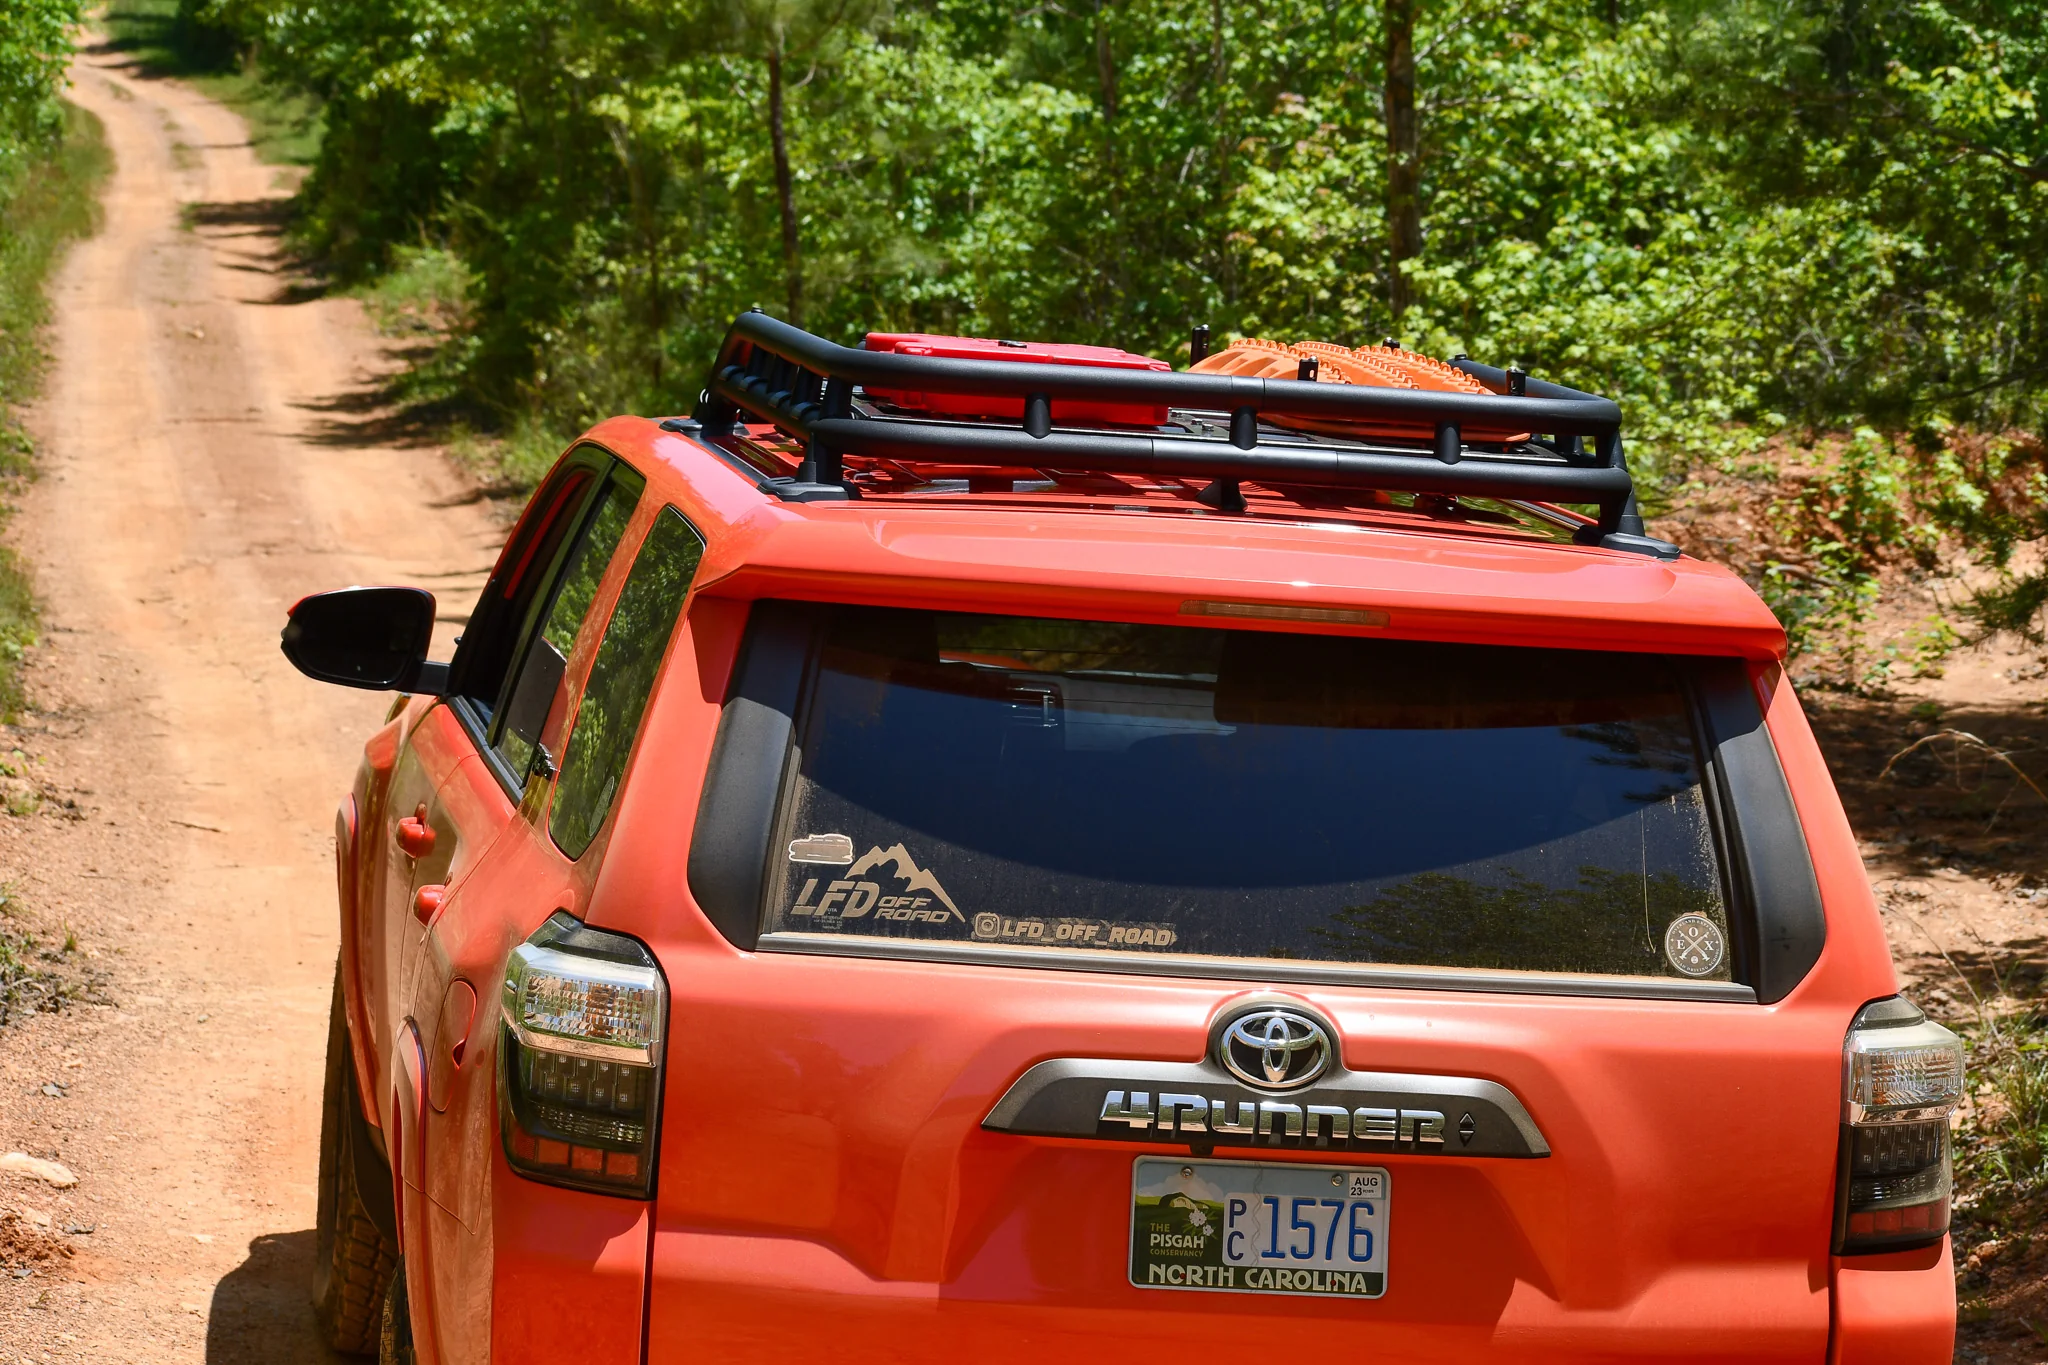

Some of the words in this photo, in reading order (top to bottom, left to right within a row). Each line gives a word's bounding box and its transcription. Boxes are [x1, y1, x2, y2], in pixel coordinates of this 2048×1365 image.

[790, 878, 879, 918] LFD
[878, 896, 932, 909] OFF
[874, 908, 951, 923] ROAD
[1002, 919, 1174, 946] LFD_OFF_ROAD
[1688, 927, 1698, 937] O
[1100, 1090, 1445, 1143] 4RUNNER
[1354, 1176, 1378, 1187] AUG
[1350, 1186, 1363, 1196] 23
[1150, 1222, 1170, 1233] THE
[1261, 1195, 1375, 1263] 1576
[1150, 1233, 1205, 1249] PISGAH
[1150, 1248, 1204, 1257] CONSERVANCY
[1149, 1263, 1234, 1287] NORTH
[1245, 1267, 1368, 1293] CAROLINA
